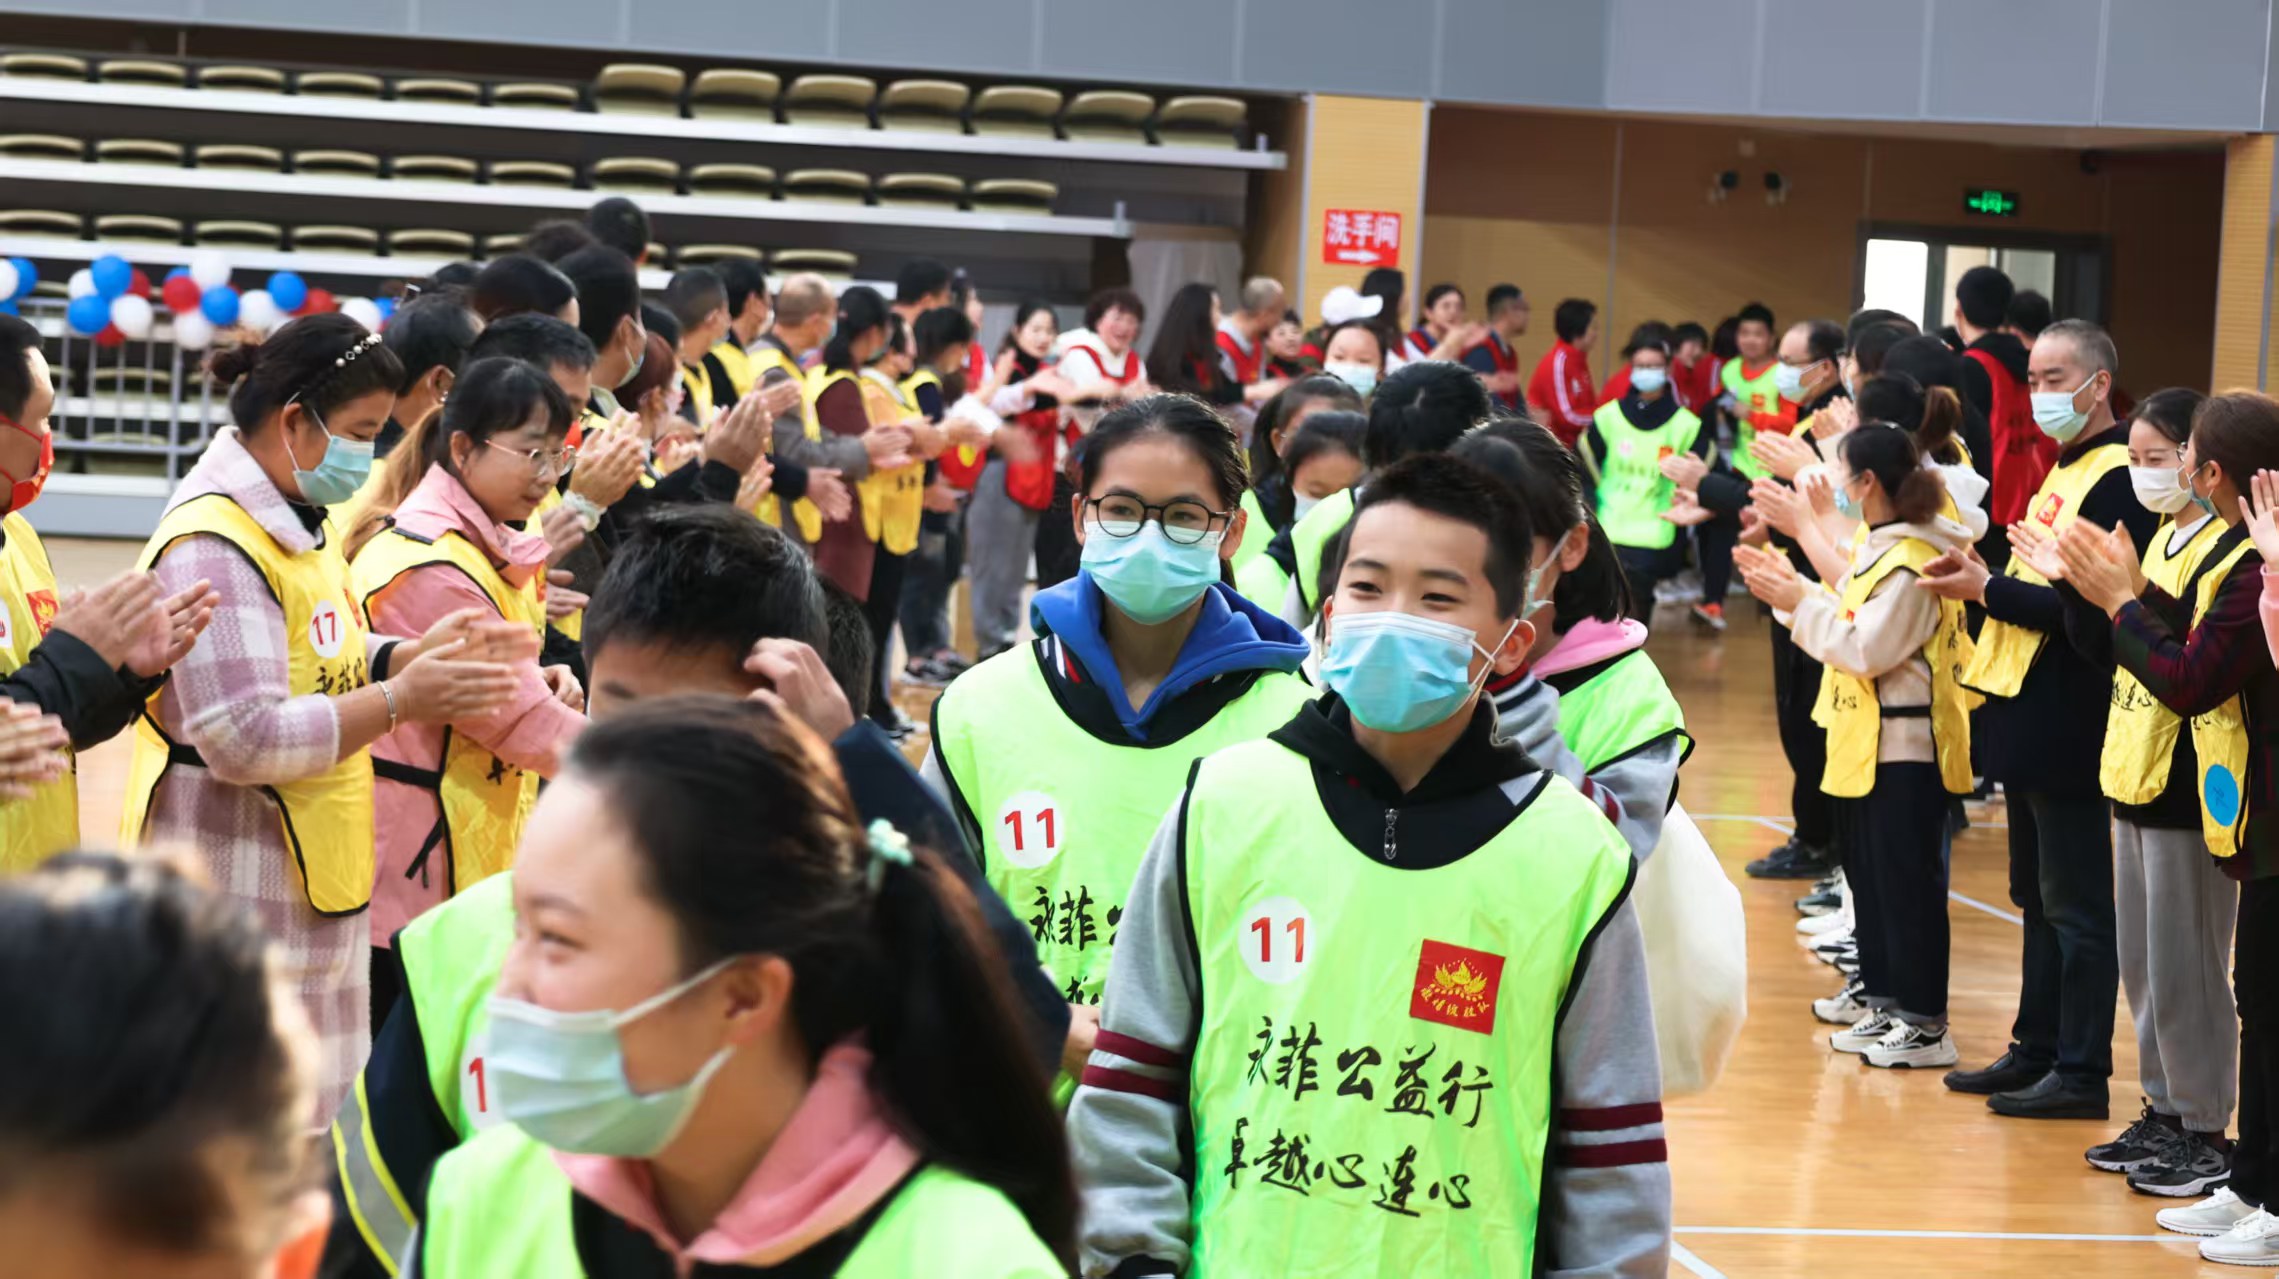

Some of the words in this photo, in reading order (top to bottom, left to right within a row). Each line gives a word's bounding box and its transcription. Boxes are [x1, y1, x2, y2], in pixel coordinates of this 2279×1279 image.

[1326, 212, 1399, 248] 洗手间
[313, 611, 336, 646] 17
[1004, 808, 1055, 850] 11
[1251, 916, 1305, 963] 11
